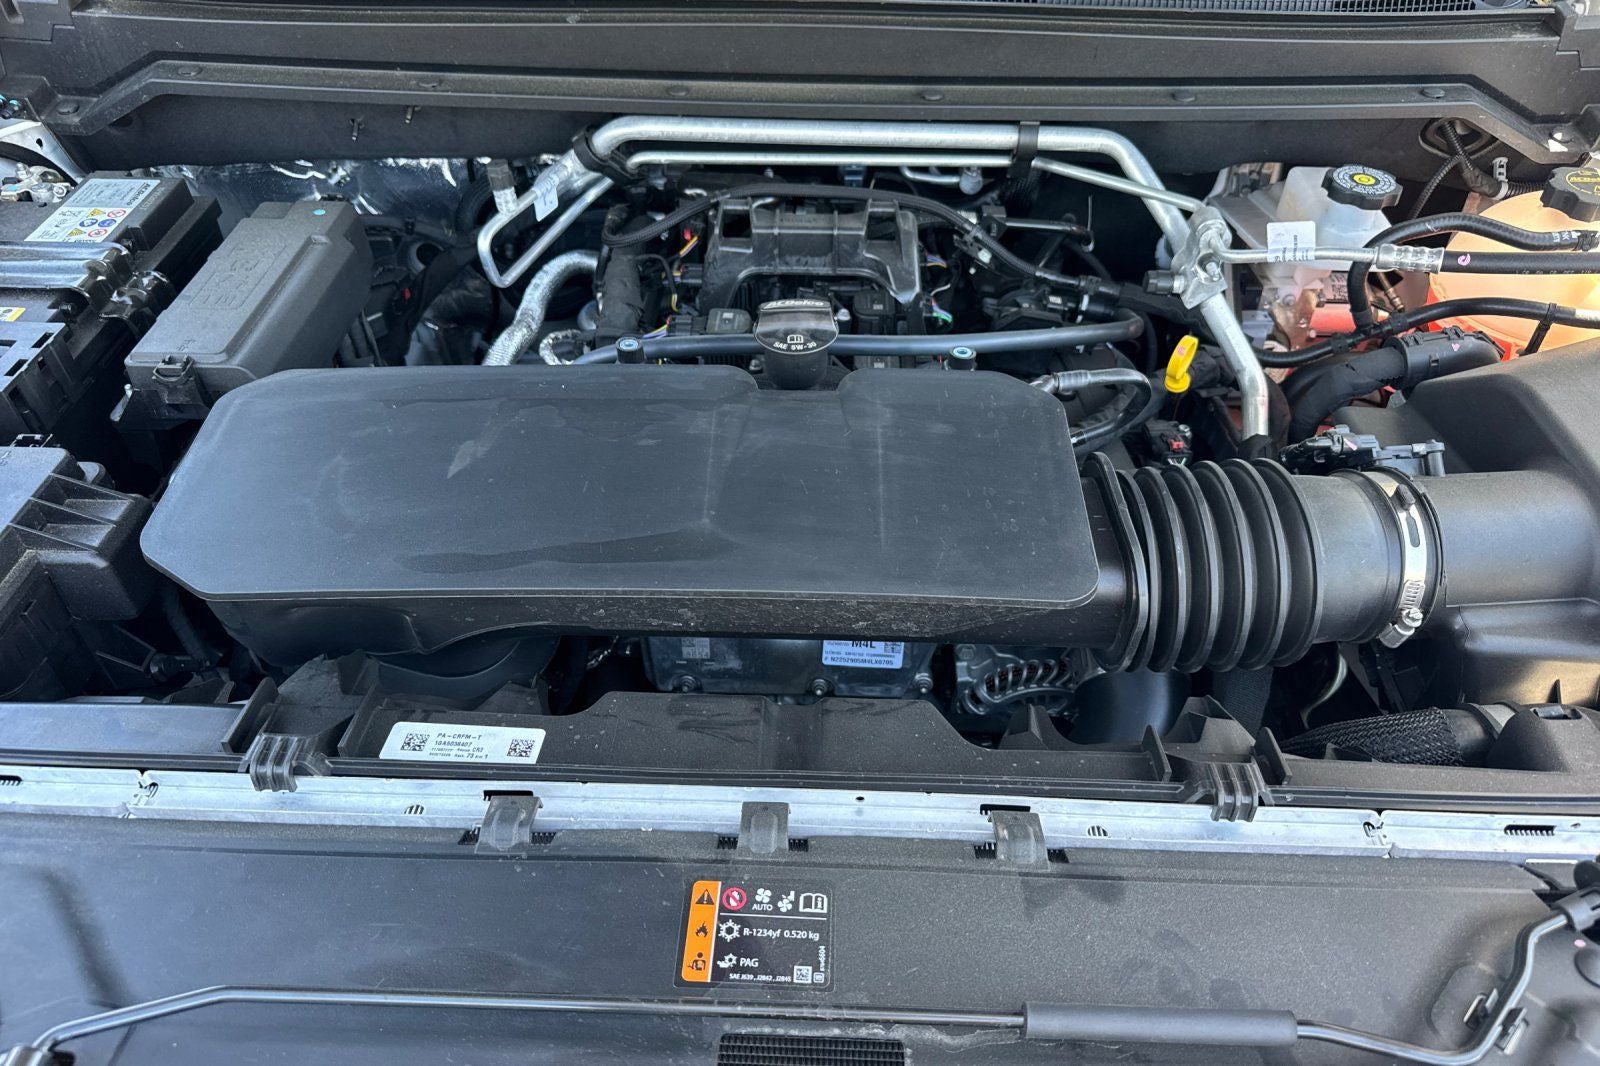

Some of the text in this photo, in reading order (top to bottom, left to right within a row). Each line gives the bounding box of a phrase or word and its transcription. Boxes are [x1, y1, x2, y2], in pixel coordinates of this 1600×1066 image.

[763, 300, 824, 309] ACDelco
[773, 341, 817, 350] SAE 5W-30
[851, 640, 876, 649] M4L
[752, 903, 774, 911] AUTO
[743, 927, 820, 941] R-1234yf 0.520 kg
[740, 957, 759, 967] PAG
